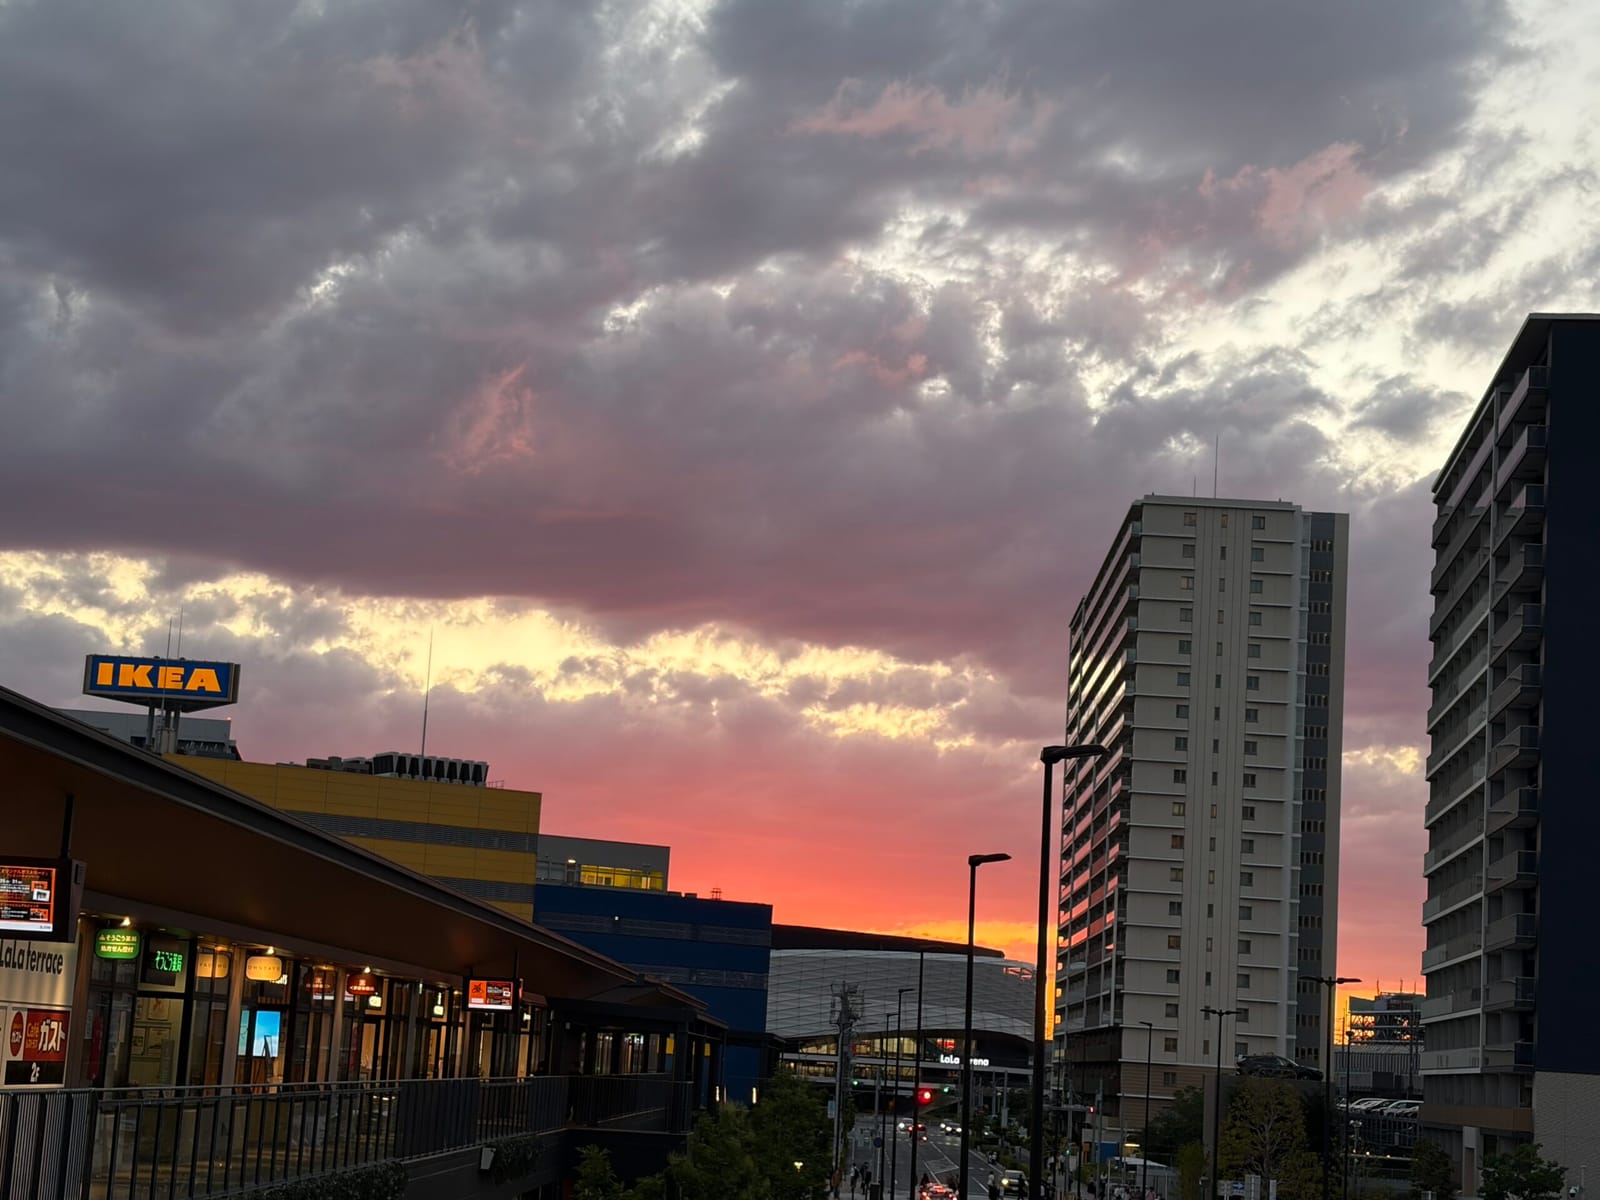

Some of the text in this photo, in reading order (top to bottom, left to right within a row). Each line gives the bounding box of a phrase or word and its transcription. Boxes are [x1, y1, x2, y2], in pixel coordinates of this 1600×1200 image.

[96, 662, 222, 692] IKEA
[38, 1018, 66, 1052] ガスト
[969, 1058, 989, 1066] rena
